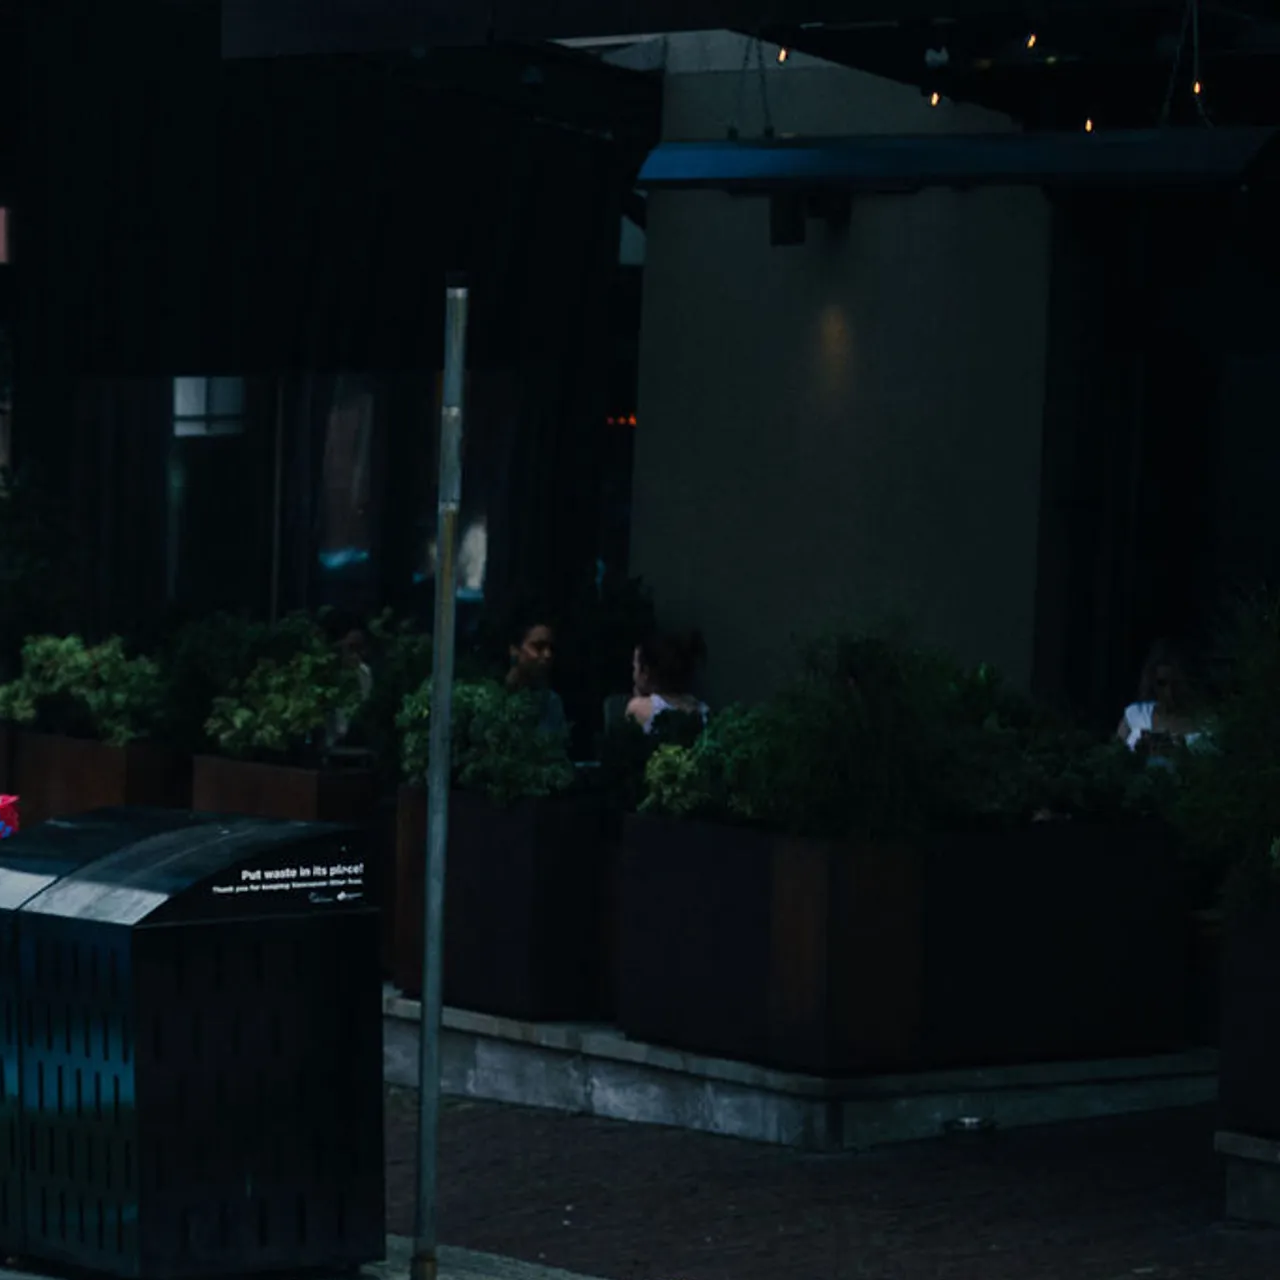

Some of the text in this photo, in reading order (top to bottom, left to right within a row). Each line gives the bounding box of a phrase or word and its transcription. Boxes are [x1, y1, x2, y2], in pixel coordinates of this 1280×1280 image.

[241, 869, 261, 881] Put
[264, 868, 297, 879] waste
[299, 866, 311, 877] in
[313, 865, 328, 877] its
